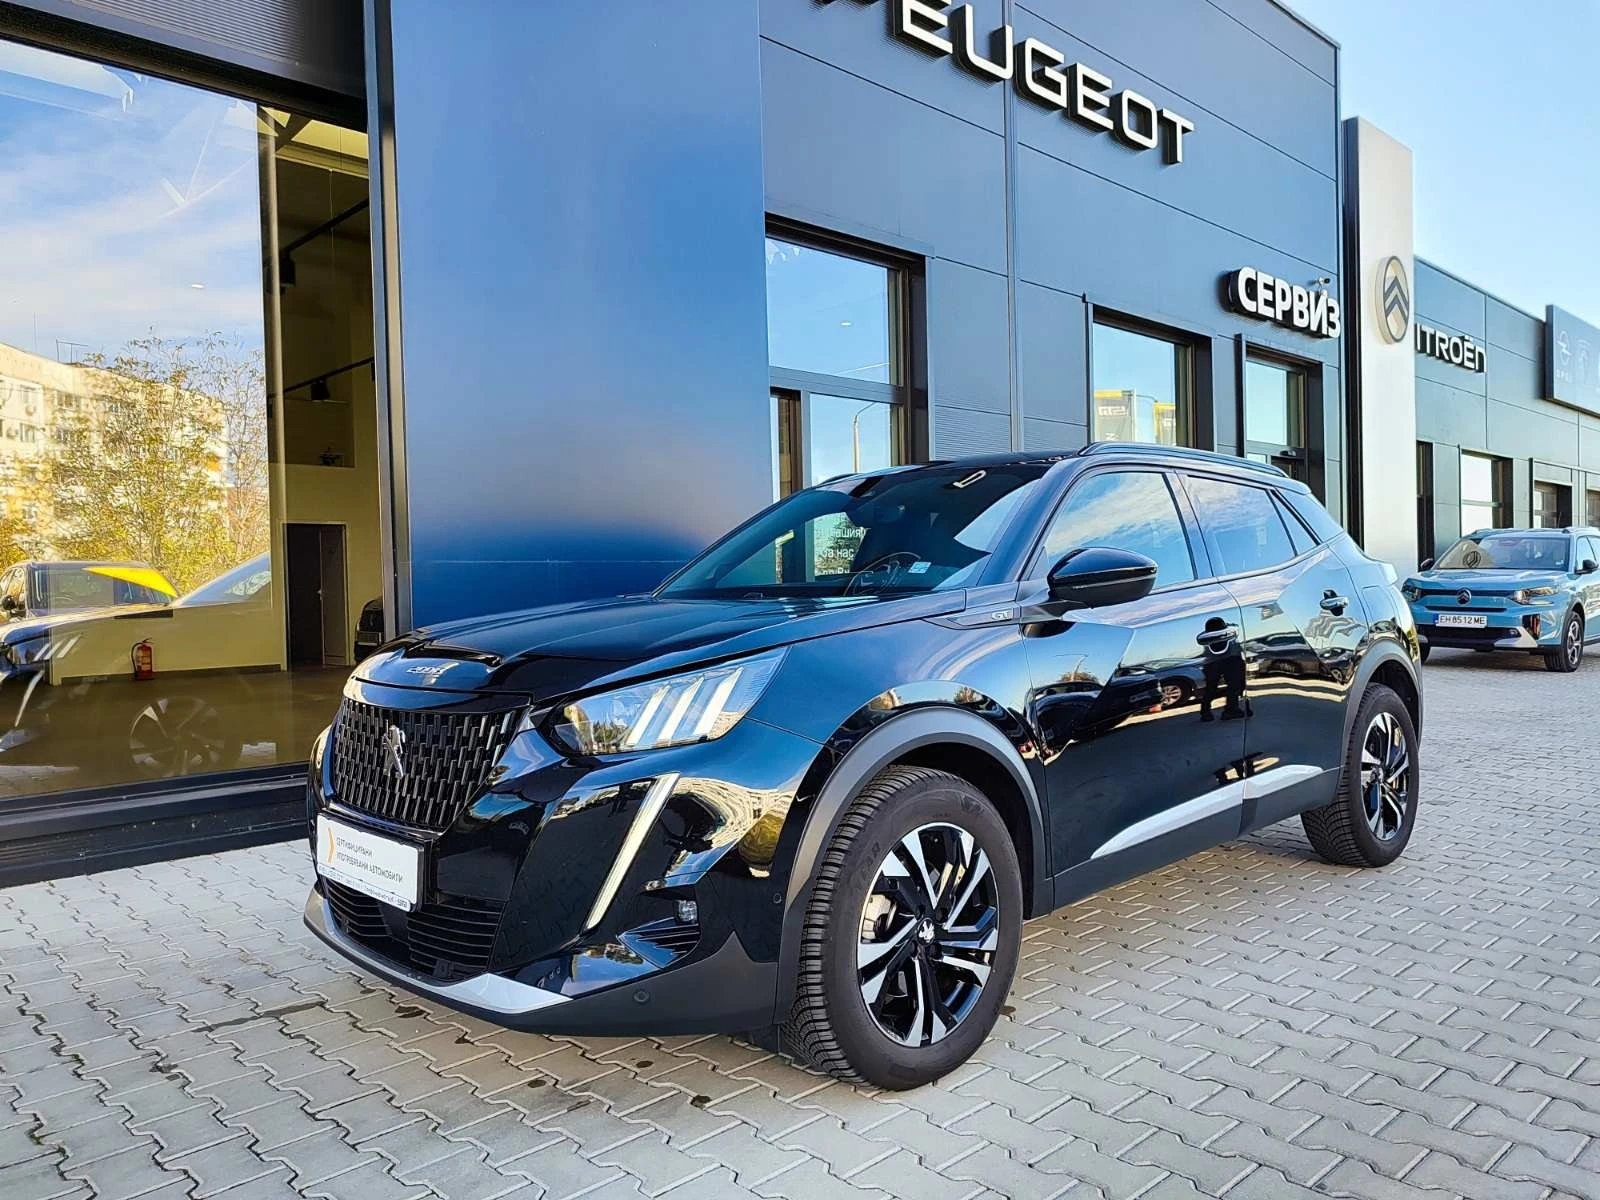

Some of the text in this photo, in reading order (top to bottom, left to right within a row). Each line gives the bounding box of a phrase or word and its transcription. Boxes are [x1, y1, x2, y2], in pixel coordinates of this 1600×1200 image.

[898, 0, 1195, 164] EUGEOT
[1237, 266, 1341, 338] СЕРВИЗ
[1415, 322, 1487, 373] ITROËN
